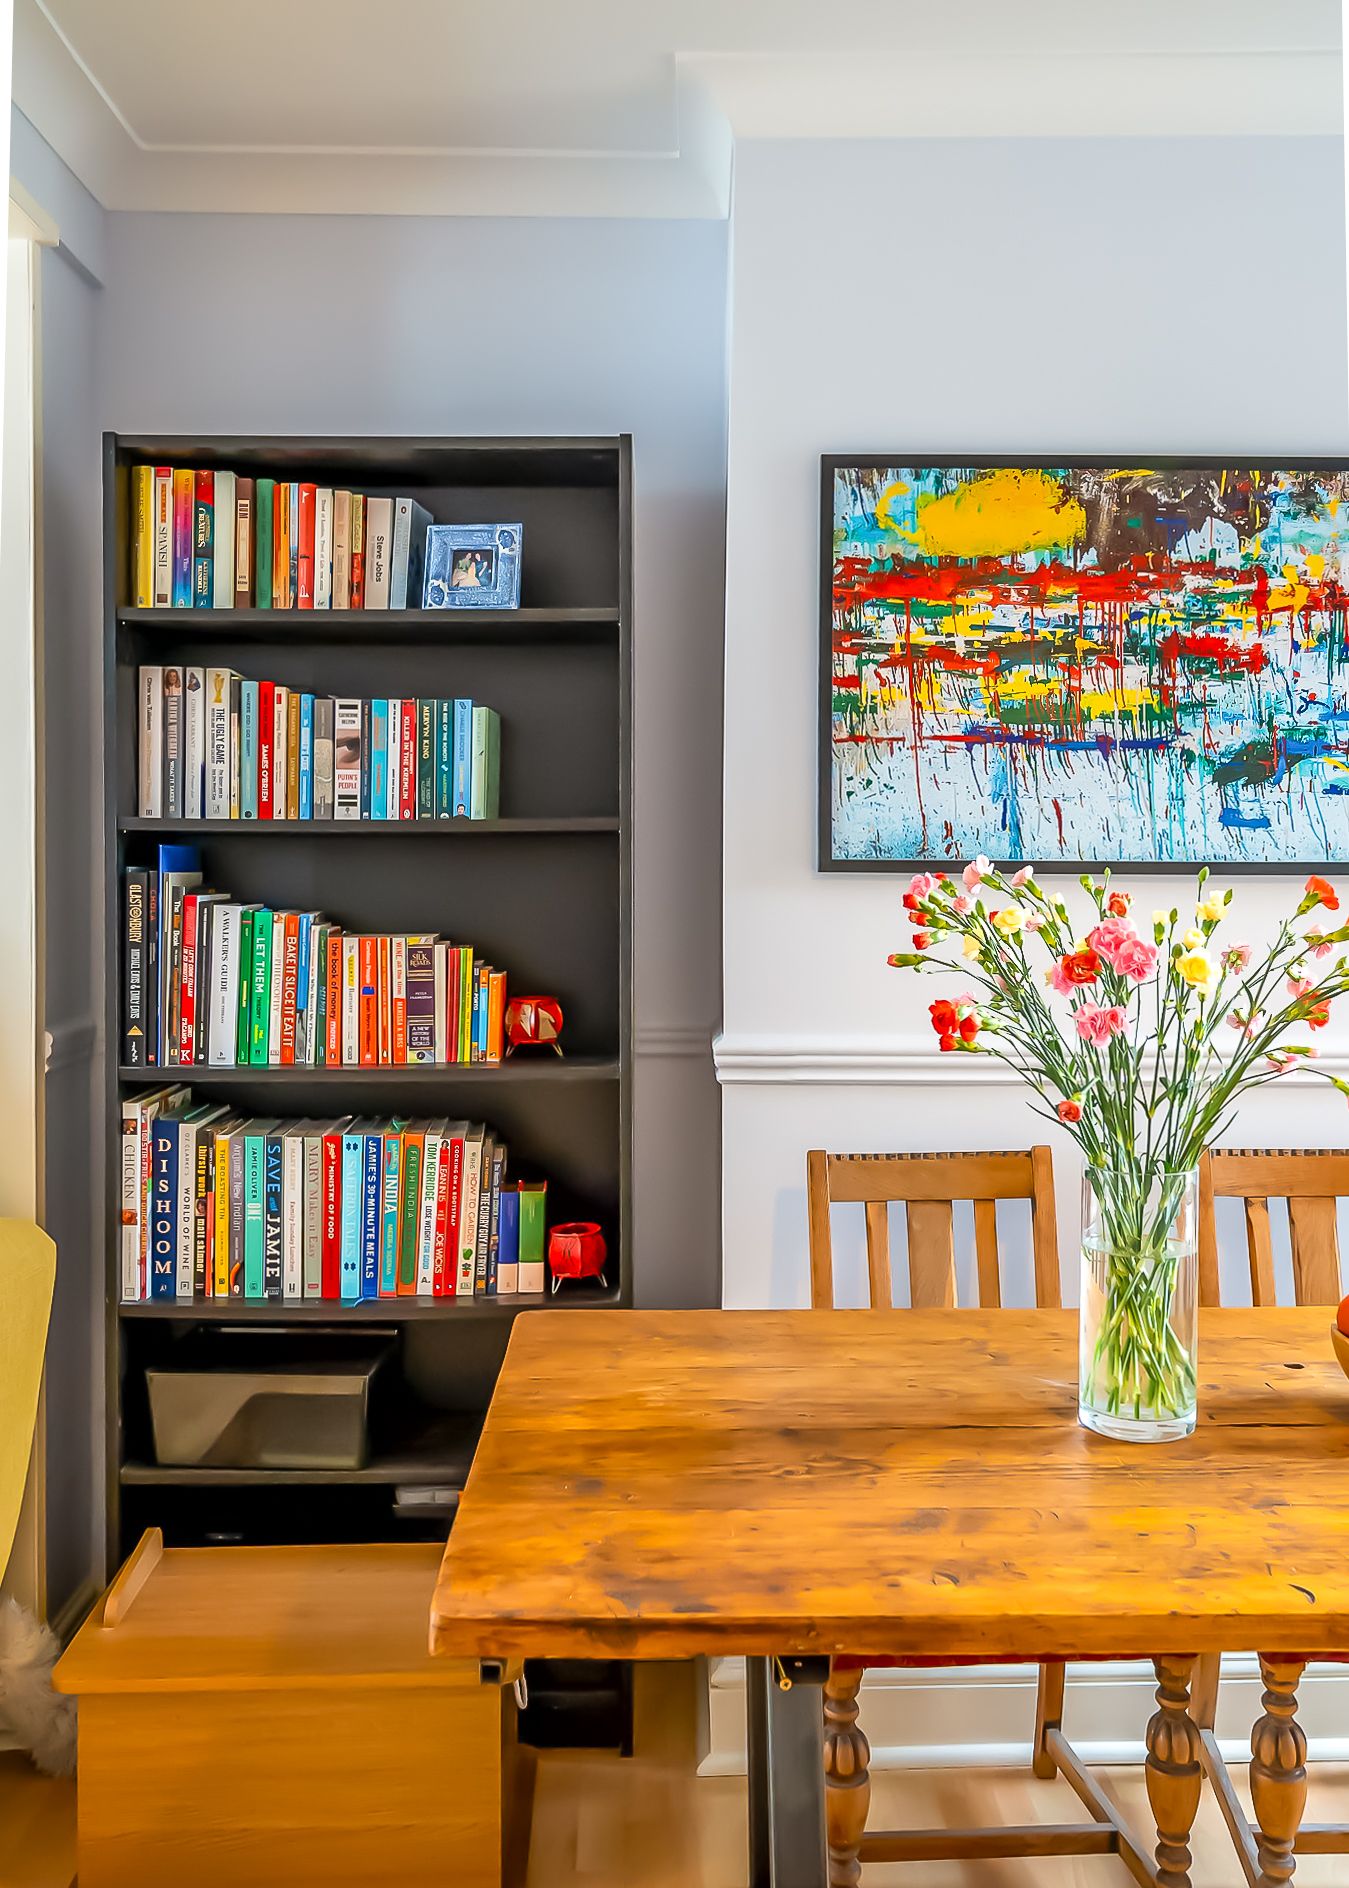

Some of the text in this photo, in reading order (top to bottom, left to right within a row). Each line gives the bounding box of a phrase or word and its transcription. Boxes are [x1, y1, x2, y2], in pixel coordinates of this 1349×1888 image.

[198, 508, 206, 548] CREATURES
[158, 527, 168, 568] SPANISH
[375, 536, 384, 582] Steve Jobs
[422, 706, 430, 737] MERVYN
[442, 724, 448, 732] OF
[216, 708, 225, 765] THE UGLY GAME
[403, 742, 410, 750] IN
[129, 884, 143, 943] GLASTONBURY
[173, 901, 181, 946] The Book
[221, 918, 230, 962] WALKER'S
[331, 943, 339, 957] the
[395, 942, 403, 957] WINE
[255, 937, 266, 993] LET THEM
[331, 959, 339, 978] book
[411, 953, 428, 961] SILK
[220, 964, 228, 992] GUIDE
[273, 959, 281, 1013] PHILOSOPHY
[331, 981, 339, 990] of
[282, 936, 297, 1047] BAKE IT SLICE IT EAT IT
[328, 991, 337, 1018] money
[181, 1050, 191, 1061] K
[185, 1132, 190, 1141] OZ
[427, 1142, 438, 1160] TOM
[124, 1144, 135, 1199] CHICKEN
[308, 1145, 319, 1184] MARY
[439, 1164, 448, 1184] LEAN
[231, 1144, 243, 1231] Anjum's New Indian
[407, 1150, 418, 1218] FRESH INDIA
[424, 1161, 437, 1202] KERRIDGE
[438, 1186, 447, 1194] IN
[453, 1174, 459, 1184] ON
[470, 1172, 478, 1195] HOW
[154, 1138, 172, 1274] DISHOOM
[384, 1174, 399, 1214] INDIA
[469, 1198, 477, 1209] TO
[480, 1191, 491, 1205] THE
[196, 1145, 207, 1273] thirsty work matt skinner
[266, 1144, 281, 1278] SAVE JAMIE
[328, 1204, 335, 1214] OF
[345, 1160, 357, 1258] SAFFRON TALES
[365, 1140, 377, 1279] JAMIE'S 30-MINUTE MEALS
[479, 1205, 490, 1229] CURRY
[183, 1227, 190, 1240] OF
[435, 1231, 445, 1247] JOE
[467, 1211, 475, 1245] GARDEN
[479, 1229, 489, 1242] GUY
[182, 1244, 190, 1270] WINE
[306, 1236, 318, 1259] Easy
[423, 1242, 431, 1253] FOR
[434, 1248, 443, 1274] WICKS
[477, 1255, 488, 1276] FRYER
